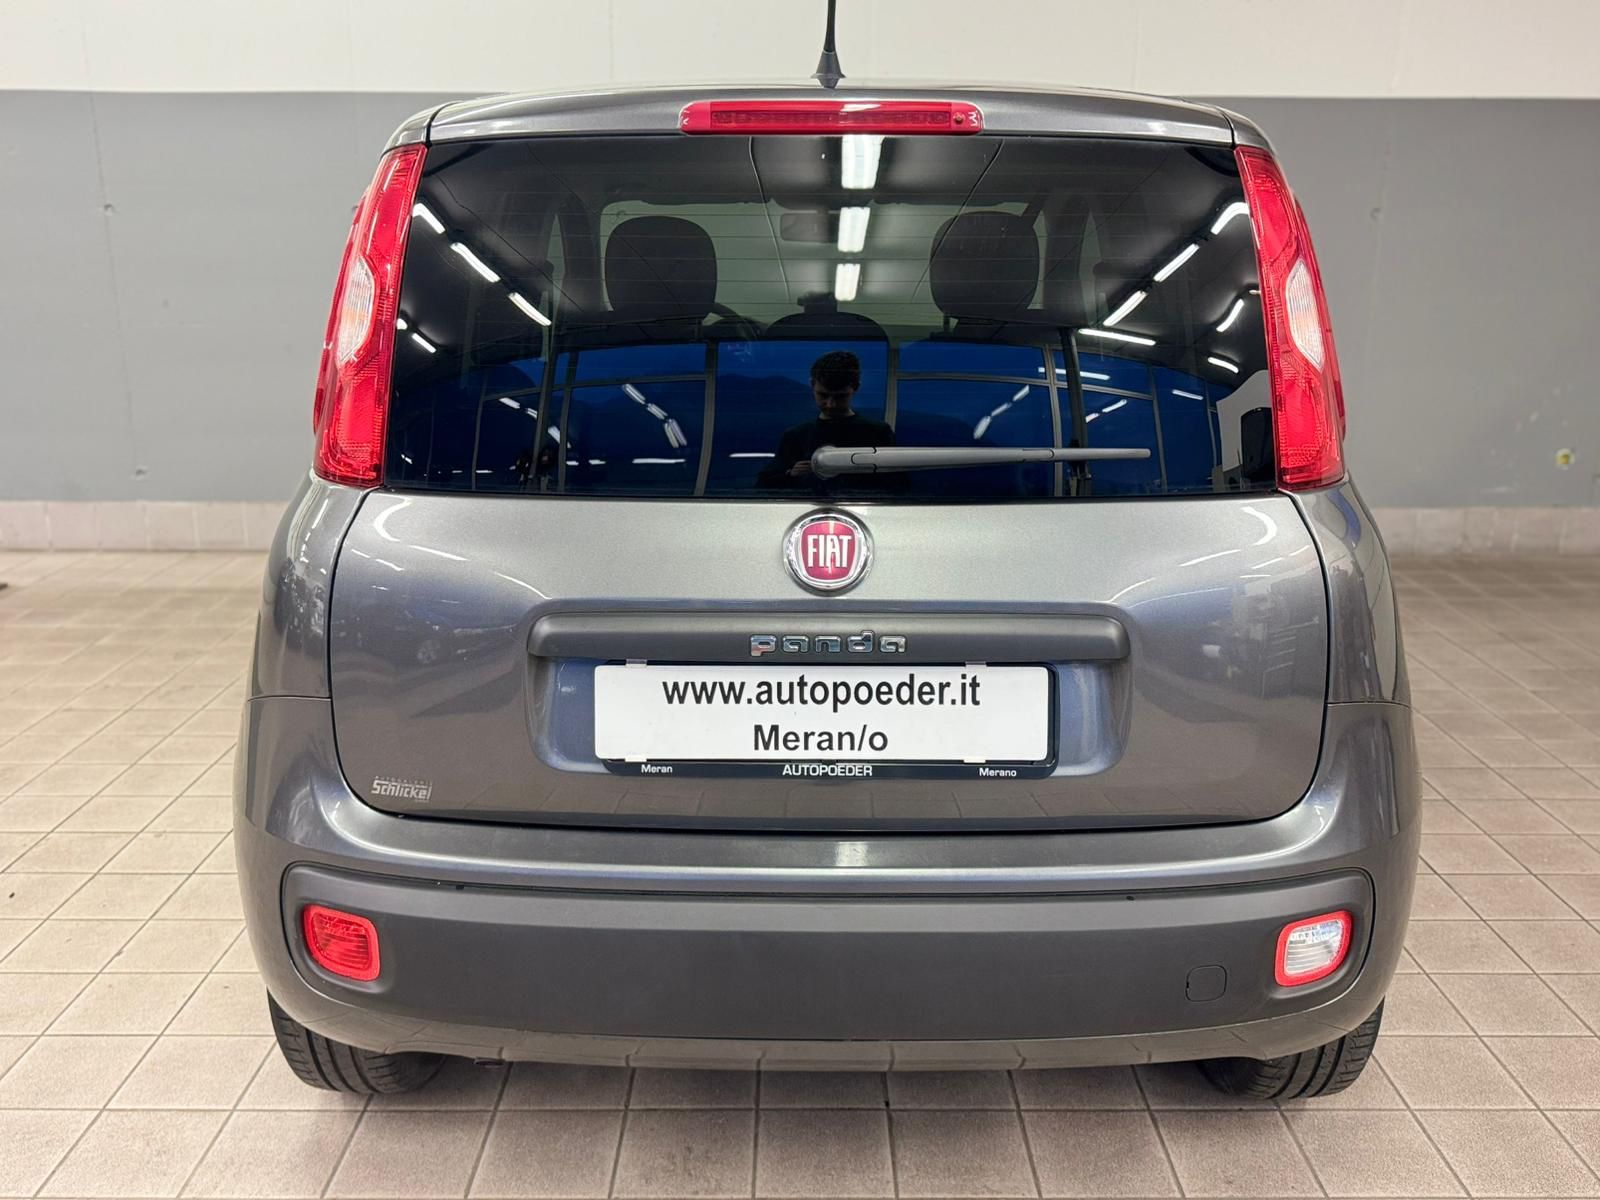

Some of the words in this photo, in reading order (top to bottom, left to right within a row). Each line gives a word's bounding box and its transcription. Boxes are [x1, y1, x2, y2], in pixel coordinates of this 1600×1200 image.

[807, 534, 852, 568] FIAT
[749, 629, 906, 657] panda
[662, 673, 981, 713] www.autopoeder.it
[753, 724, 889, 752] Meran/o
[641, 764, 673, 774] Meran
[782, 763, 873, 777] AUTOPOEDER
[979, 767, 1017, 779] Merano
